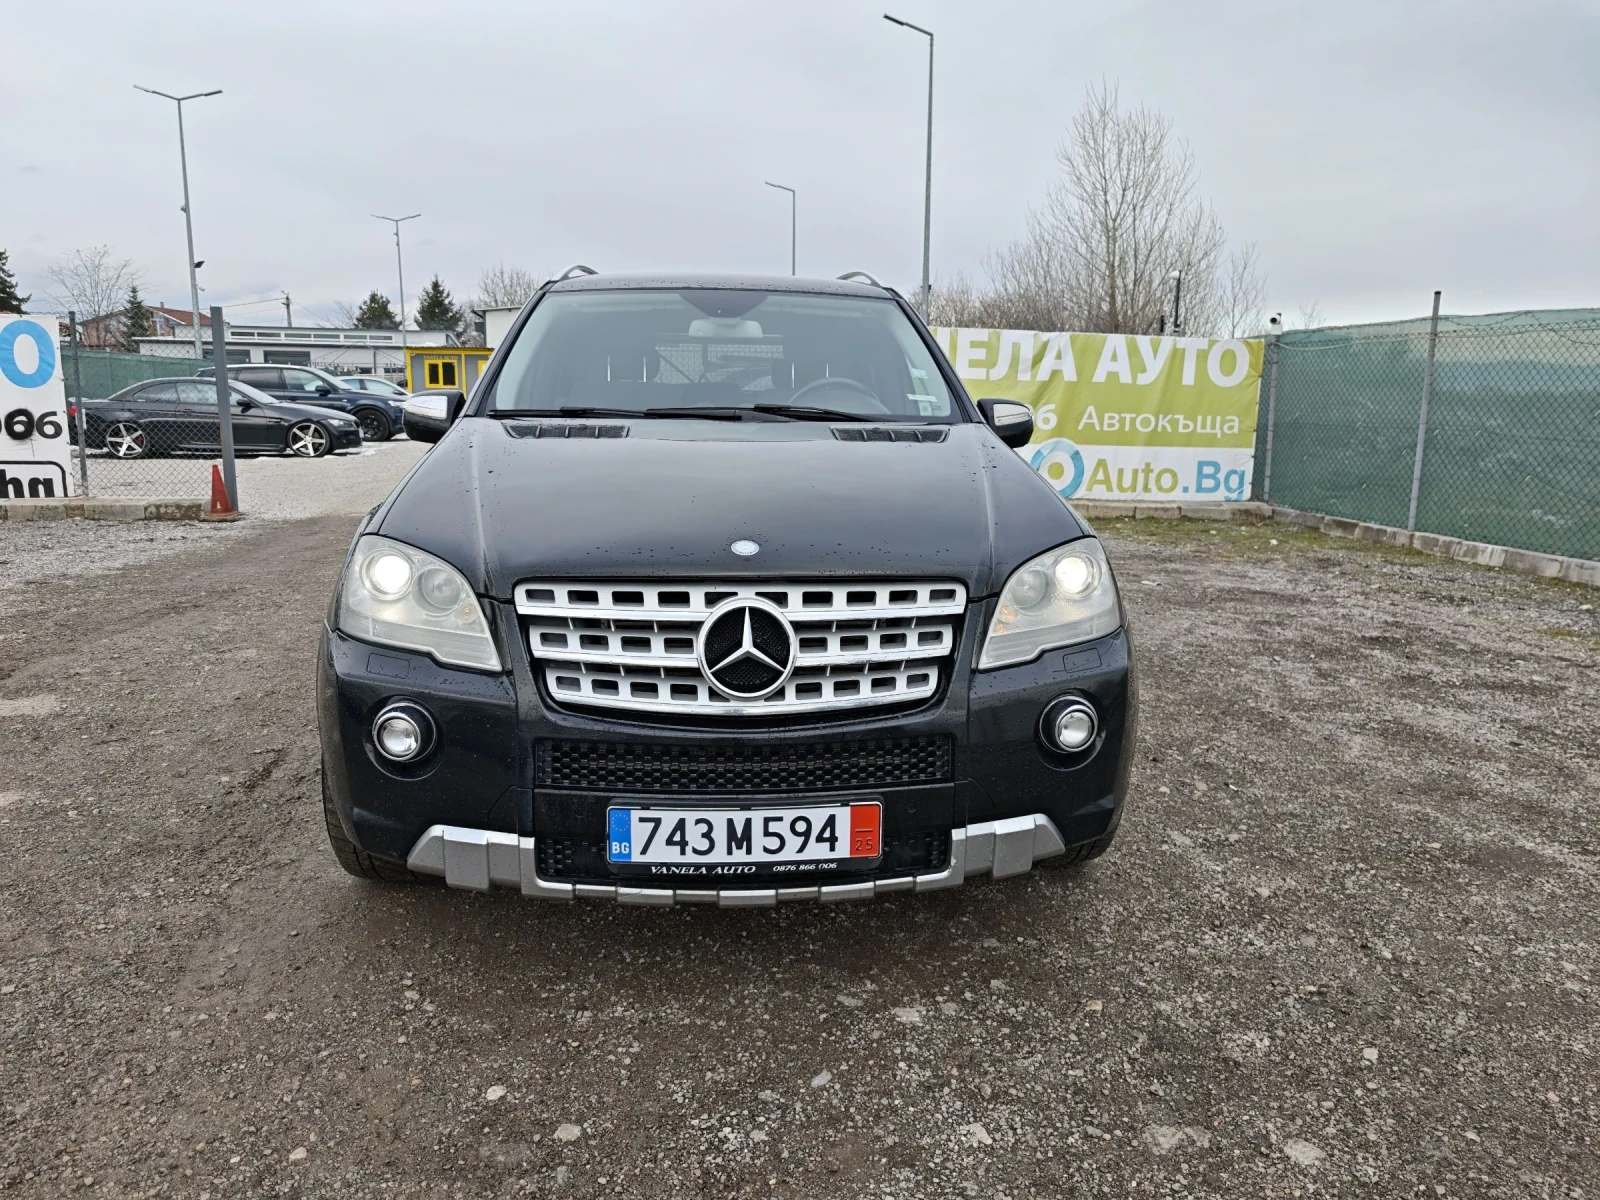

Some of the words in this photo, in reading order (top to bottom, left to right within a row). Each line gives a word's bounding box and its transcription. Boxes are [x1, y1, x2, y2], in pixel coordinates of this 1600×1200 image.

[1092, 332, 1250, 388] АУТО
[1085, 458, 1246, 500] Auto.Bg
[611, 841, 630, 854] BG
[855, 837, 874, 851] 25
[650, 866, 707, 875] VANELA
[712, 865, 756, 875] AUTO
[772, 864, 797, 872] 0876
[798, 863, 817, 871] 866
